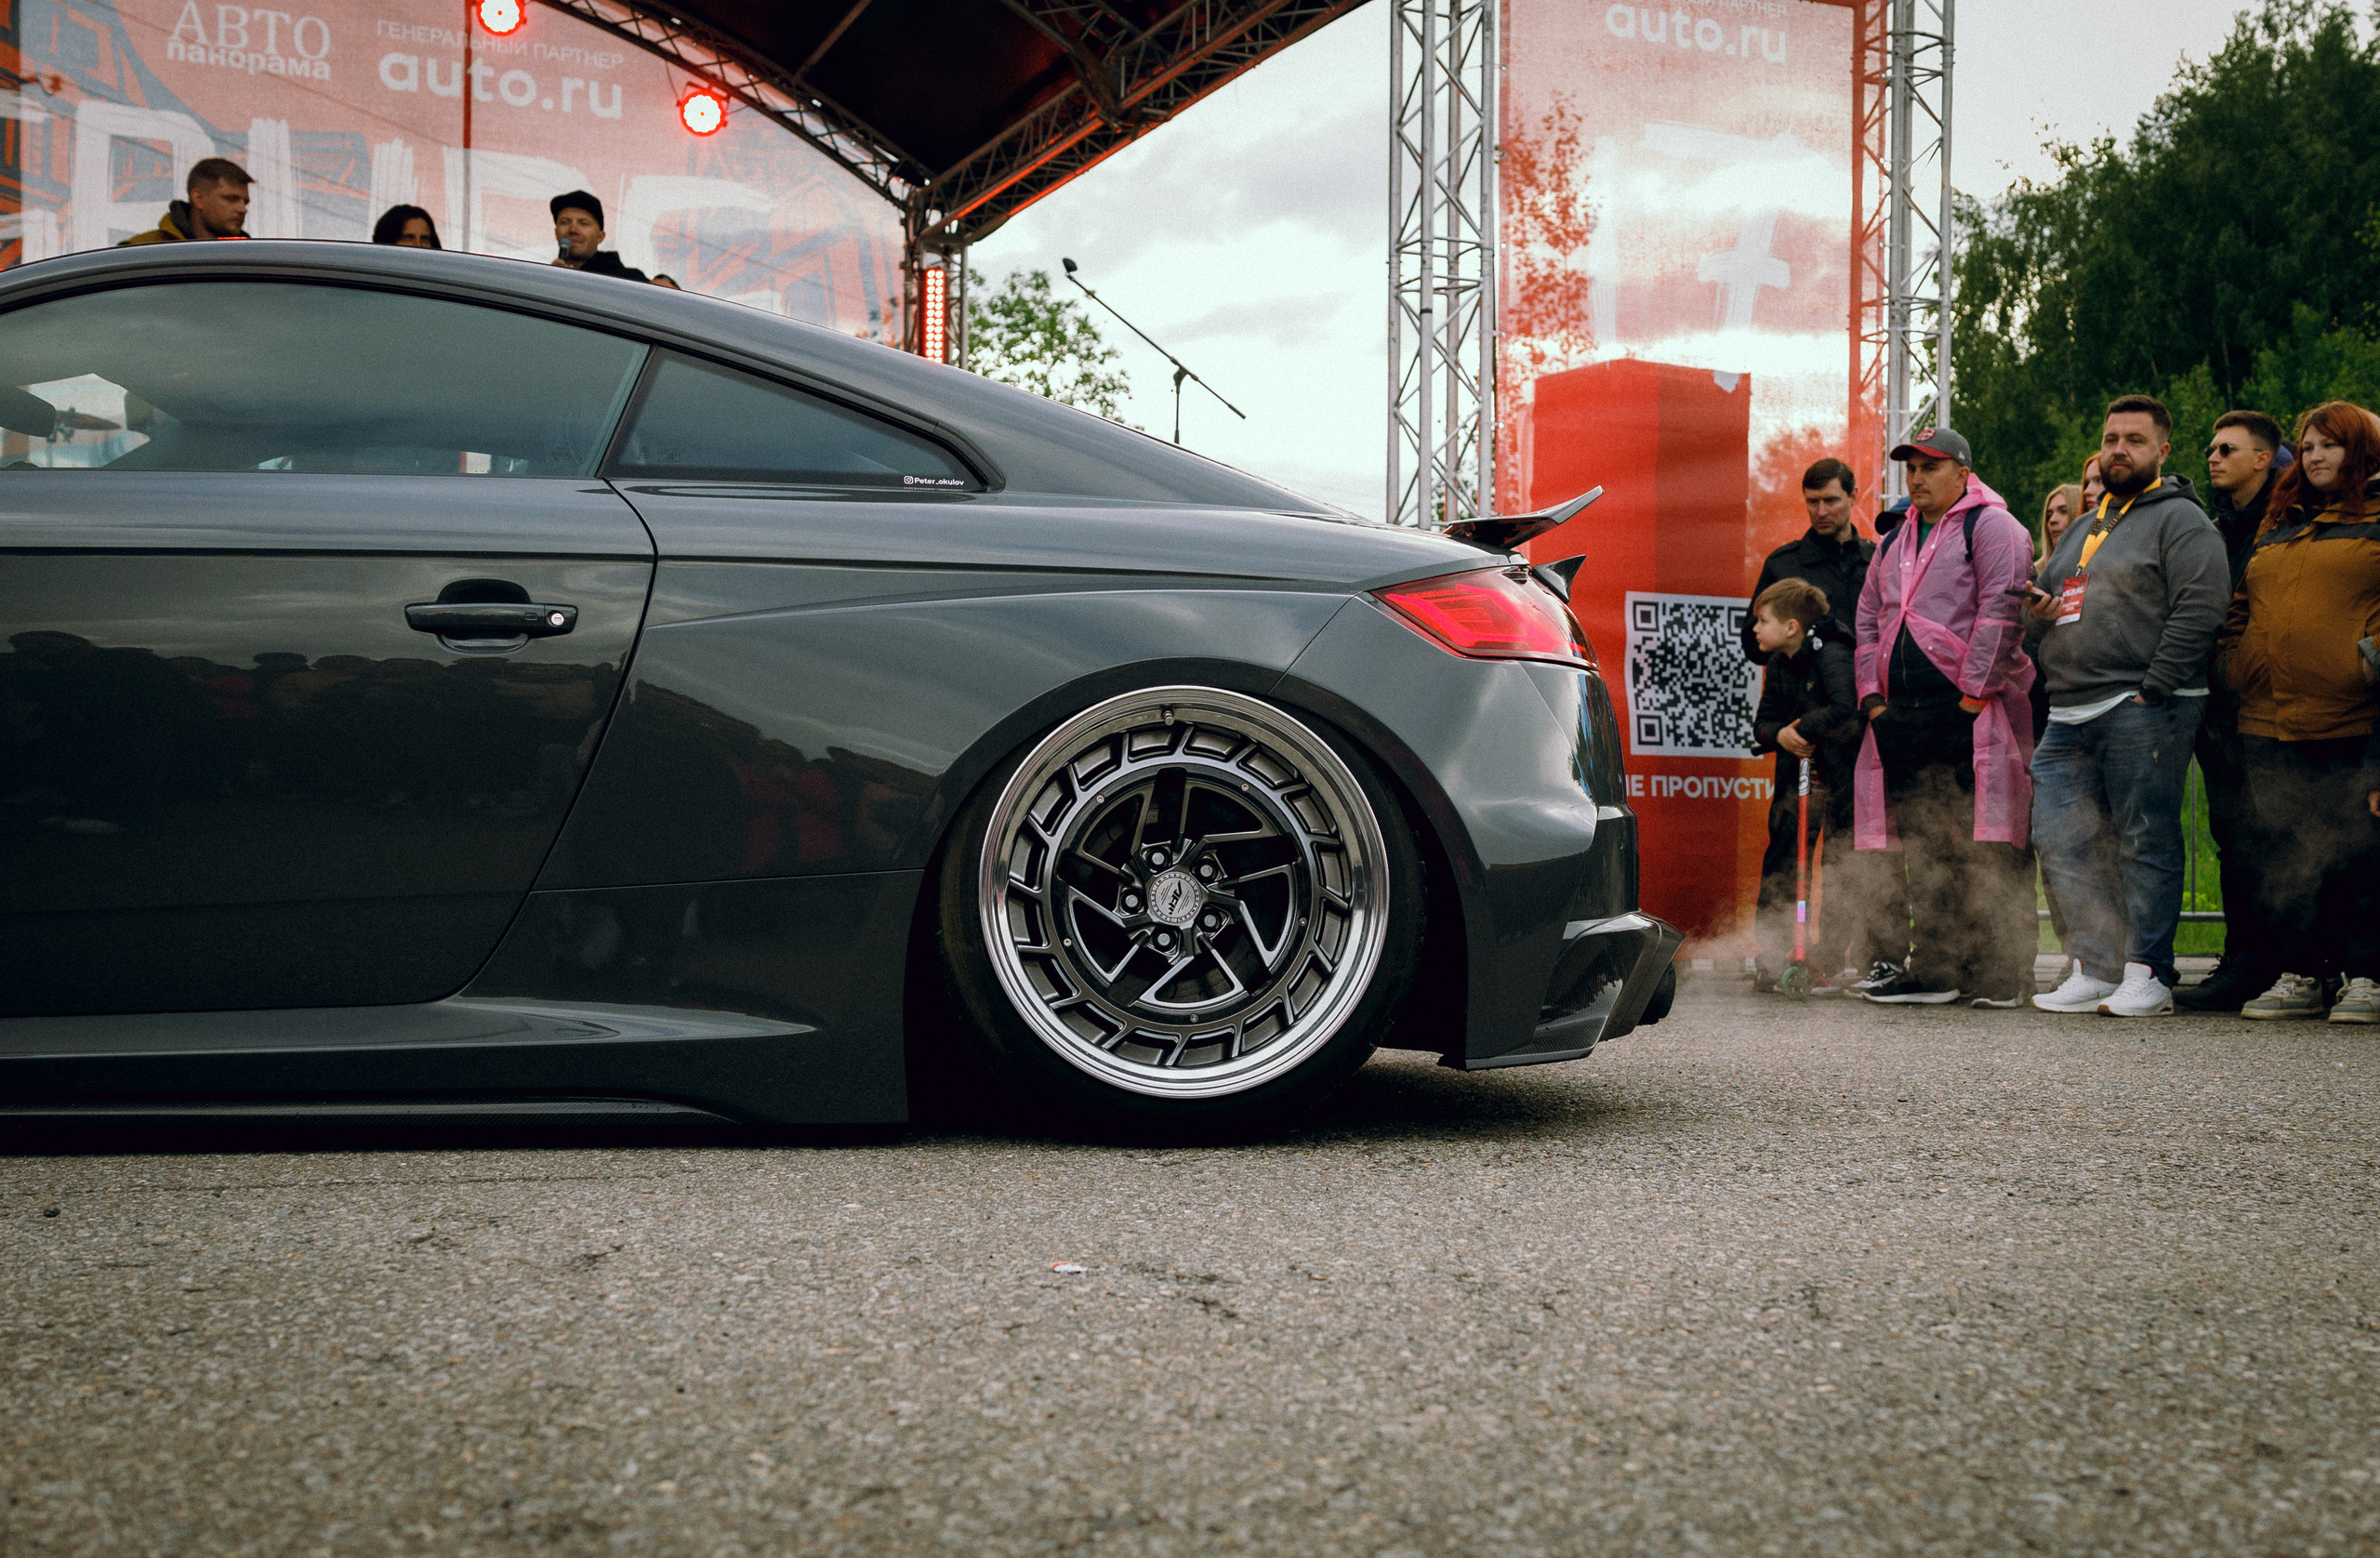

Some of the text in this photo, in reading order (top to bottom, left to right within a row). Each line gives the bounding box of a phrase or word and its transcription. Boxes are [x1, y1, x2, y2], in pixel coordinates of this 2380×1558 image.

[168, 0, 331, 60] АВТО
[1606, 4, 1787, 63] auto.ru
[166, 41, 331, 80] панорама
[533, 42, 624, 70] ПАРТНЕР
[377, 52, 623, 120] auto.ru
[914, 477, 964, 485] Peter_okulov
